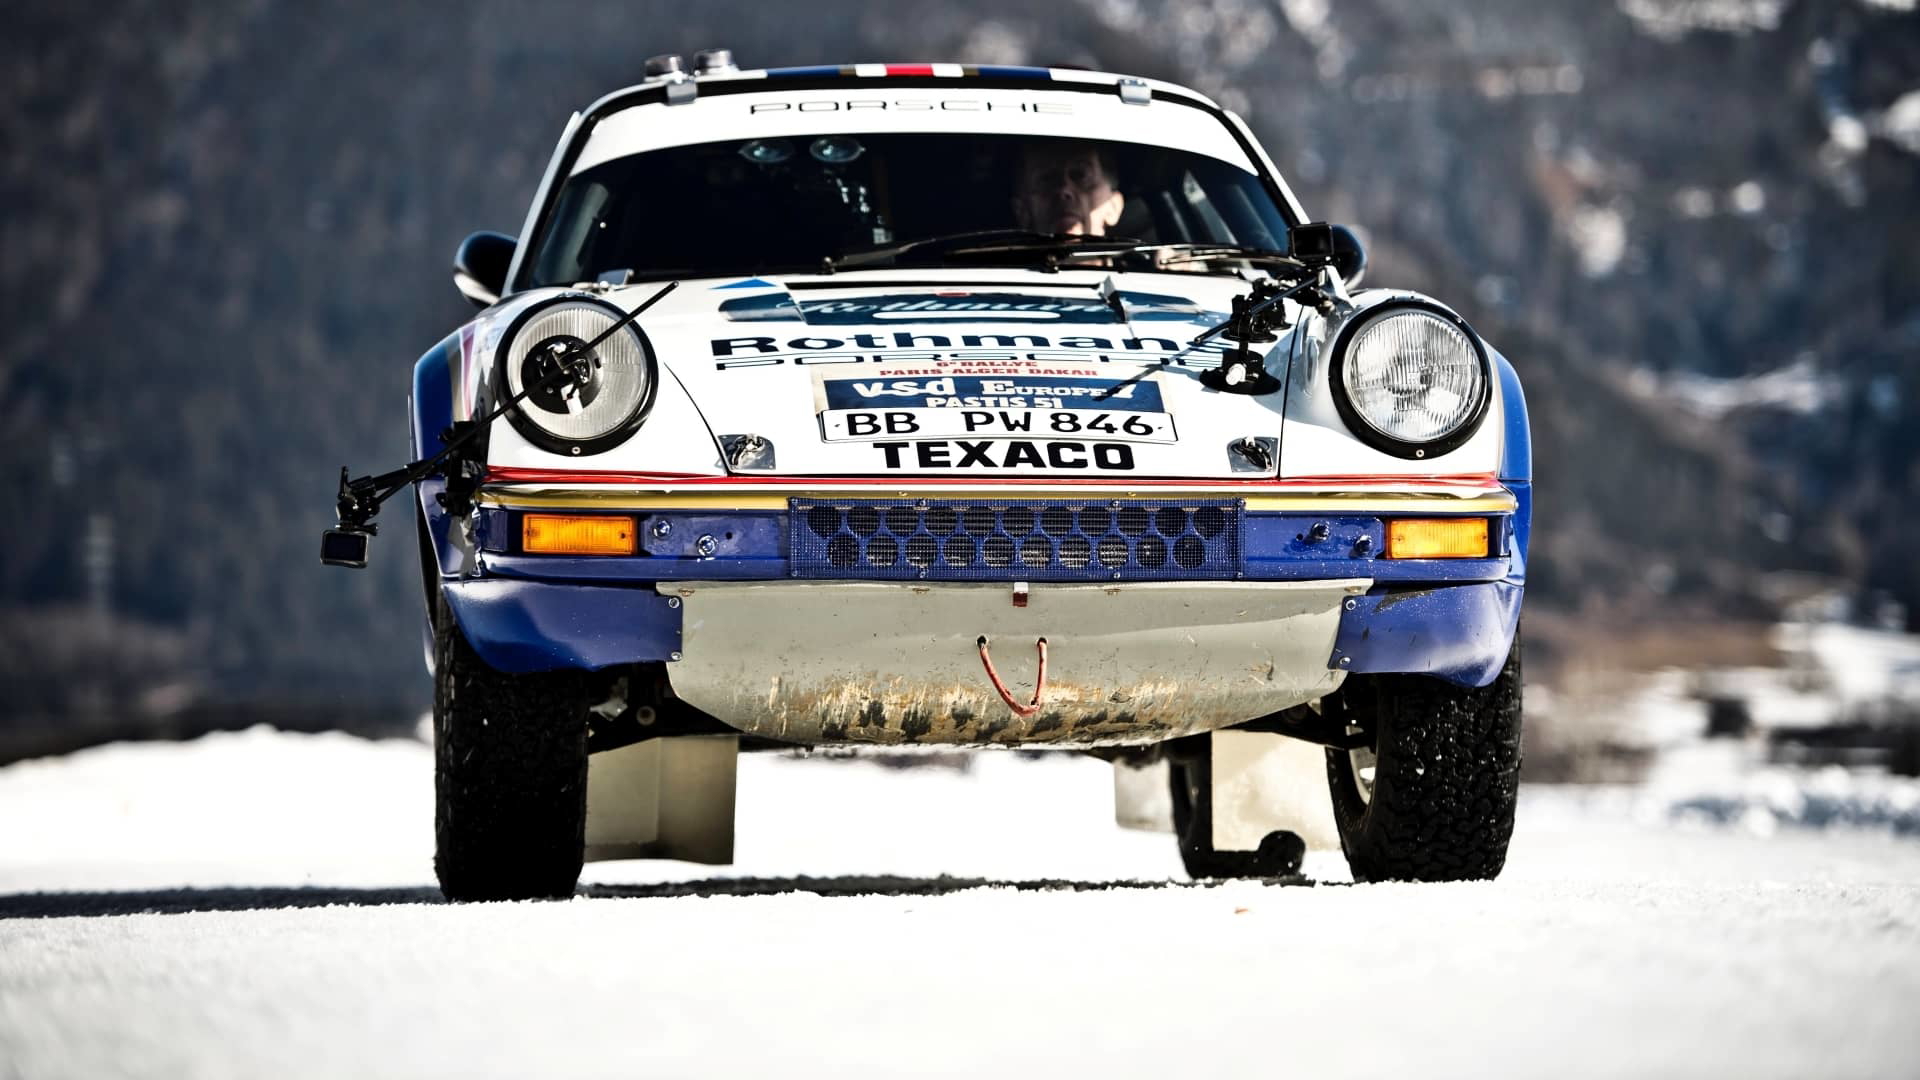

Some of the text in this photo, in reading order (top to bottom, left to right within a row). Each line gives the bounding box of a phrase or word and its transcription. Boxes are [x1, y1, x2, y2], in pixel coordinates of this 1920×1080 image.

[751, 101, 1073, 114] PORSCHE
[711, 332, 1233, 355] Rothmans
[926, 396, 1064, 409] PASTIS 51
[846, 411, 1154, 436] BB PW 846
[872, 440, 1136, 470] TEXACO
